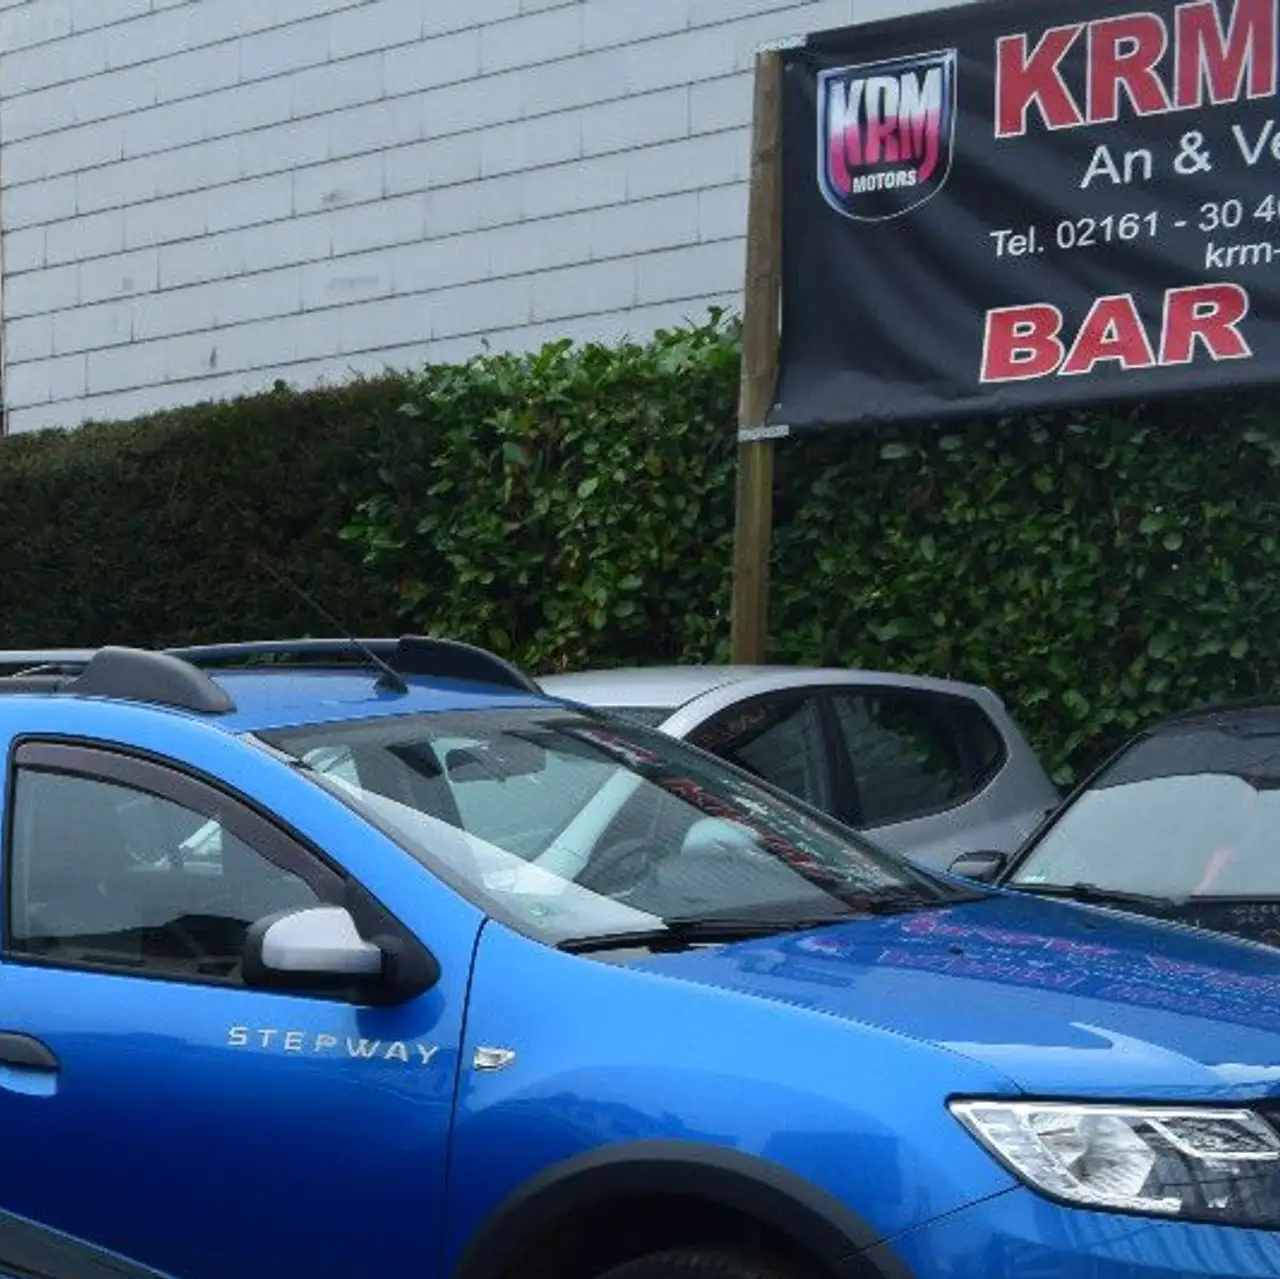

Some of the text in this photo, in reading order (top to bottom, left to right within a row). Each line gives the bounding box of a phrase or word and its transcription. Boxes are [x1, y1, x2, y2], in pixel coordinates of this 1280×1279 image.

[994, 0, 1278, 138] KRM
[831, 69, 940, 193] KRM
[1080, 145, 1152, 188] An
[1173, 130, 1211, 174] &
[852, 169, 917, 194] MOTORS
[989, 226, 1044, 257] Tel.
[1056, 211, 1159, 249] 02161
[1198, 199, 1243, 231] 30
[1253, 194, 1280, 222] 4
[979, 283, 1252, 383] BAR
[228, 1026, 439, 1065] STEPWAY
